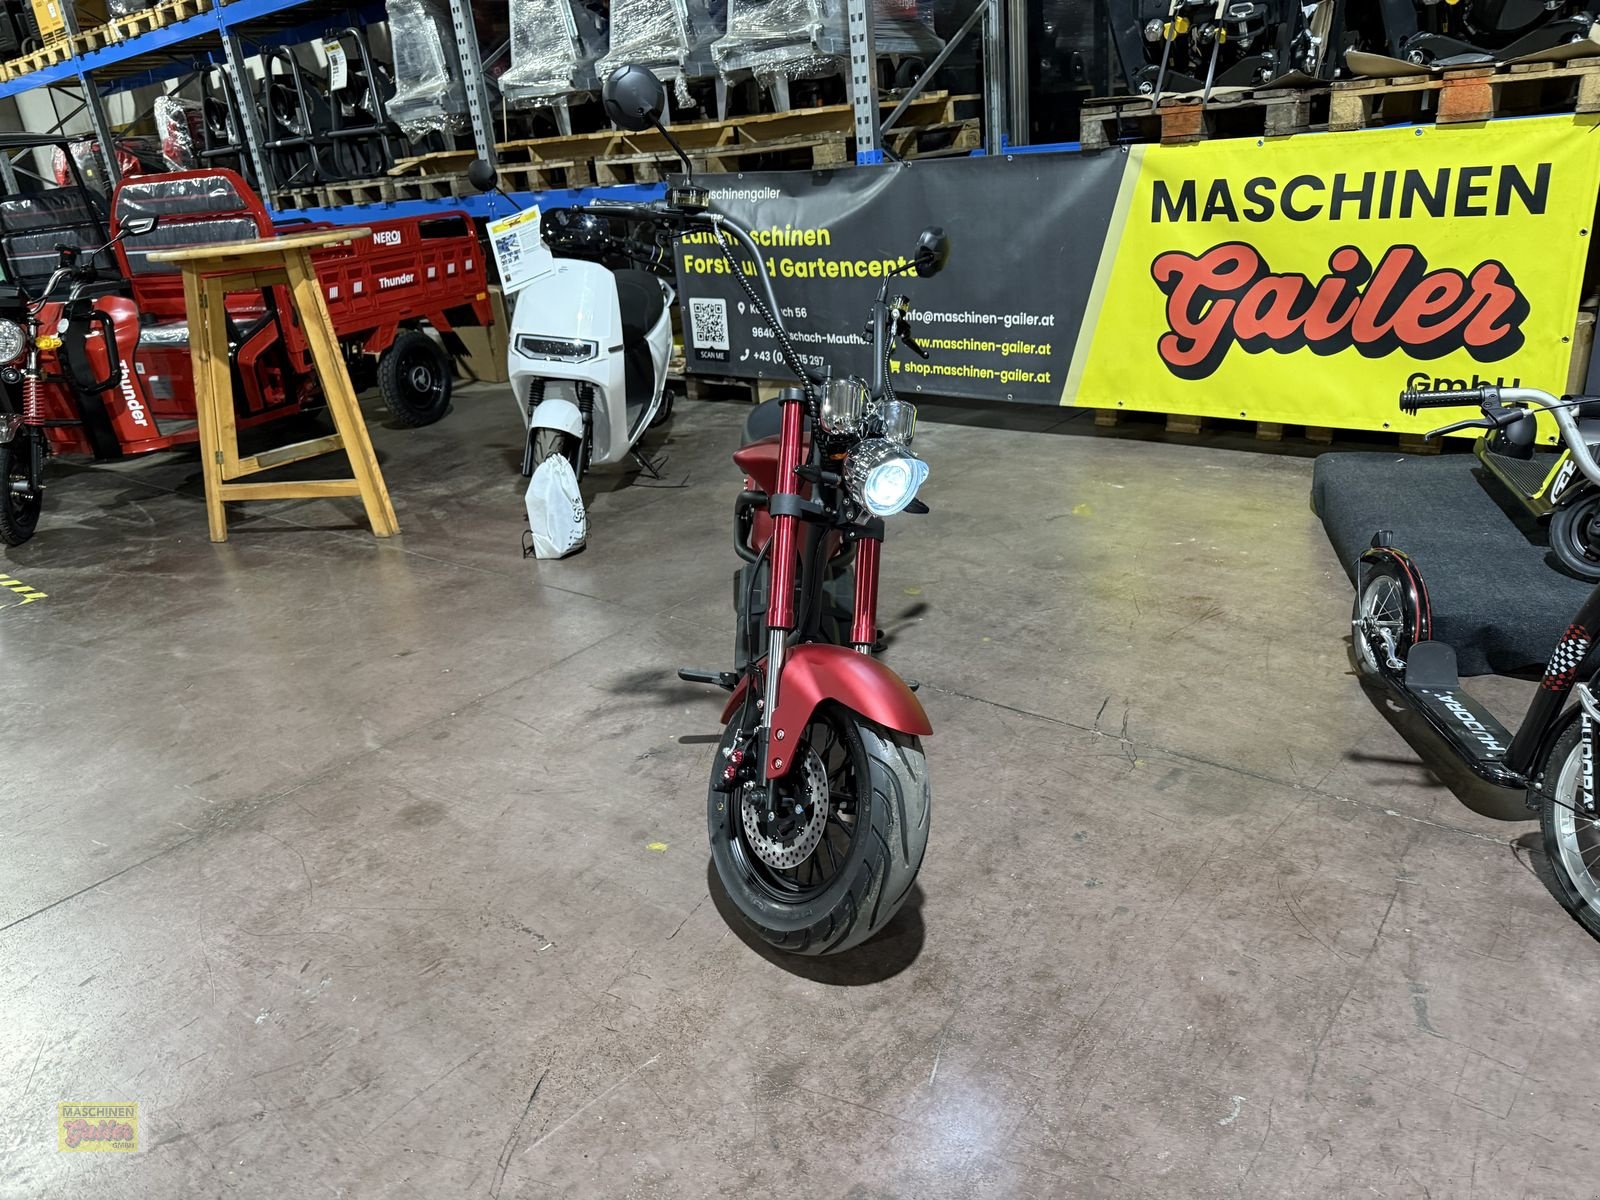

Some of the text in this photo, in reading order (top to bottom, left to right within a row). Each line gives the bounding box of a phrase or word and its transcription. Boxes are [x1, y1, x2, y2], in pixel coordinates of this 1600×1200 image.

[708, 186, 781, 203] schinengailer
[1150, 162, 1552, 223] MASCHINEN
[379, 273, 414, 289] Thunder
[794, 307, 808, 319] 56
[903, 309, 1054, 328] nfo@maschinen-gailer.at
[1150, 240, 1530, 381] Gailer
[700, 351, 725, 360] SCAN ME
[753, 350, 771, 361] +43
[809, 355, 824, 366] 297
[904, 361, 1051, 383] shop.maschinen-gailer.at
[1438, 695, 1506, 751] HUDORA
